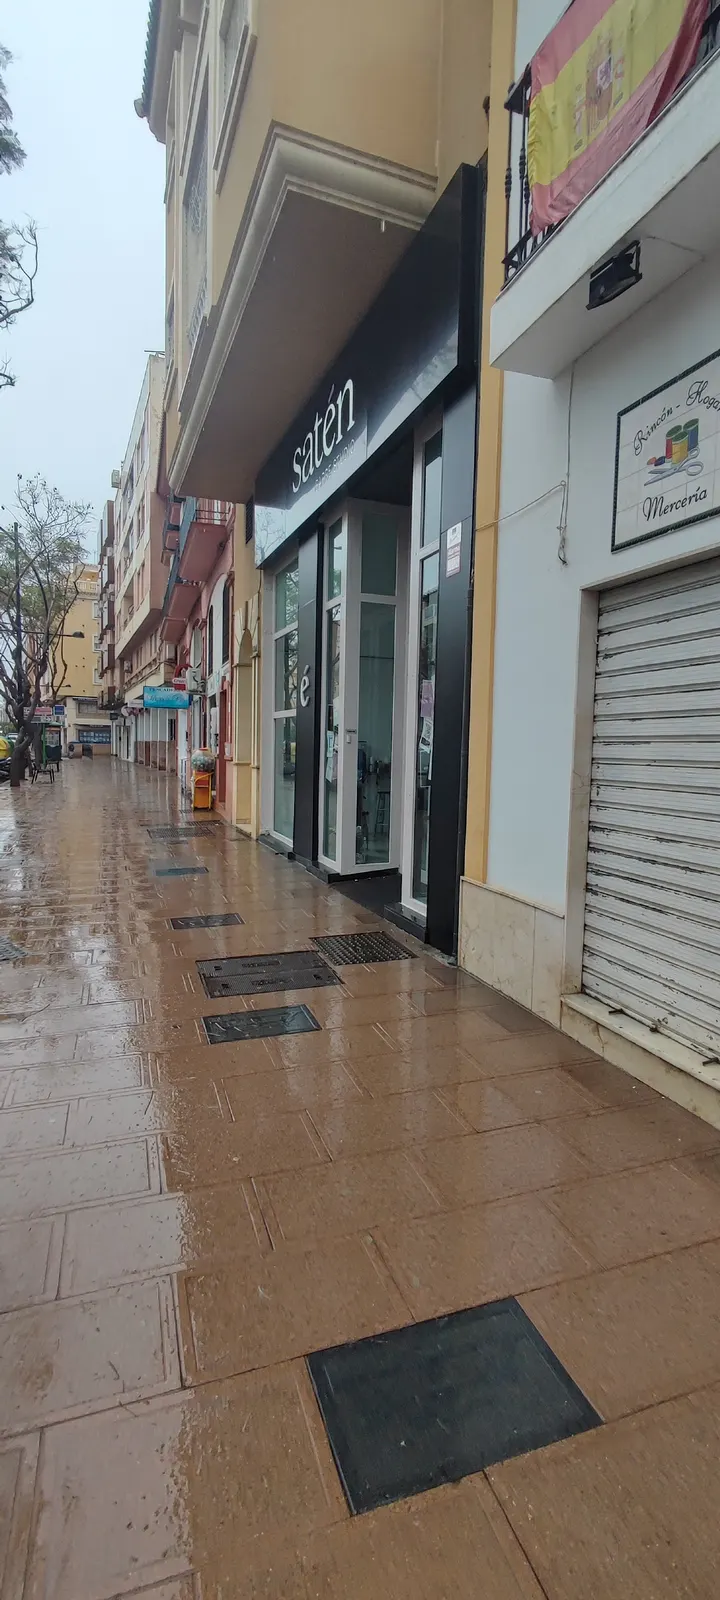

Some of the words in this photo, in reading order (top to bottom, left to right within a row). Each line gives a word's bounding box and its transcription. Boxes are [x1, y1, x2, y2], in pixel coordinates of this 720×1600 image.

[292, 378, 356, 494] satén
[633, 406, 674, 456] Rincón
[642, 486, 708, 521] Mercería
[300, 665, 310, 707] é
